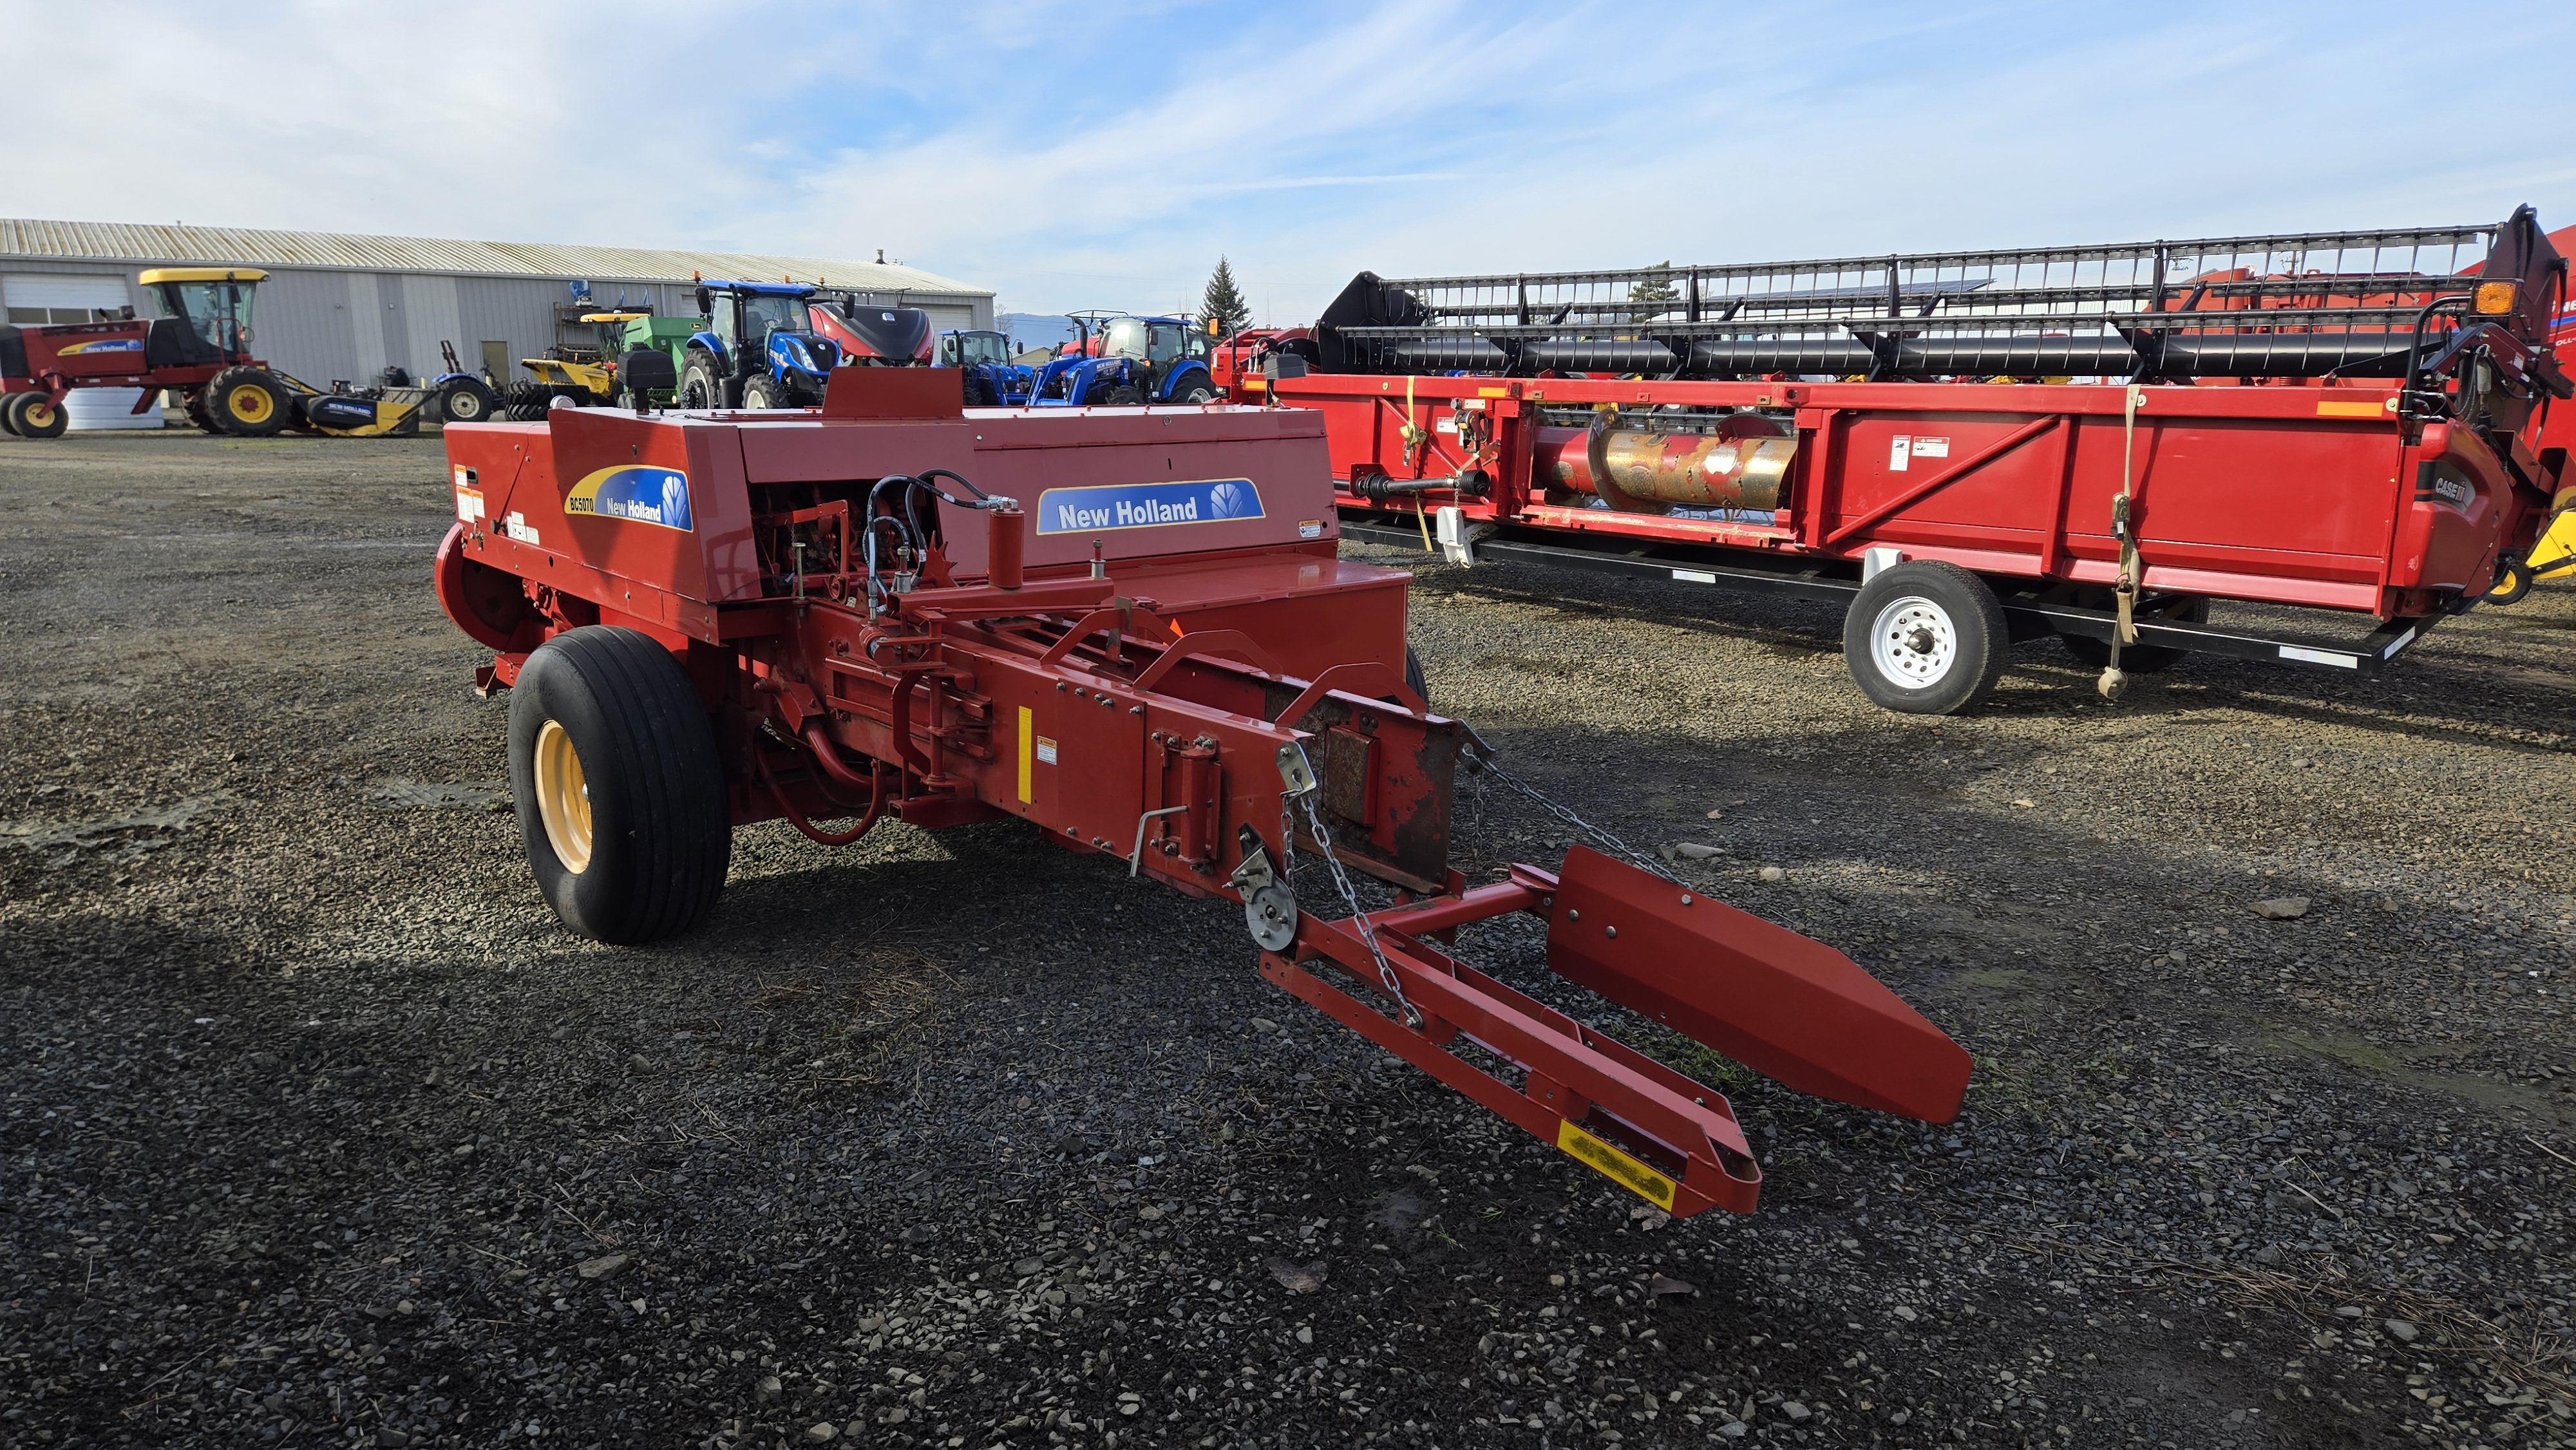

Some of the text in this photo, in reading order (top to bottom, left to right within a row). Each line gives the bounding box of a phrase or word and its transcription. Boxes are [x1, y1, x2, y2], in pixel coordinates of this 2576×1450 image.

[343, 406, 371, 415] HOLLAND
[2435, 477, 2458, 498] CASE
[570, 496, 594, 512] BC5070
[607, 497, 661, 522] New Holland
[1058, 496, 1198, 529] New Holland
